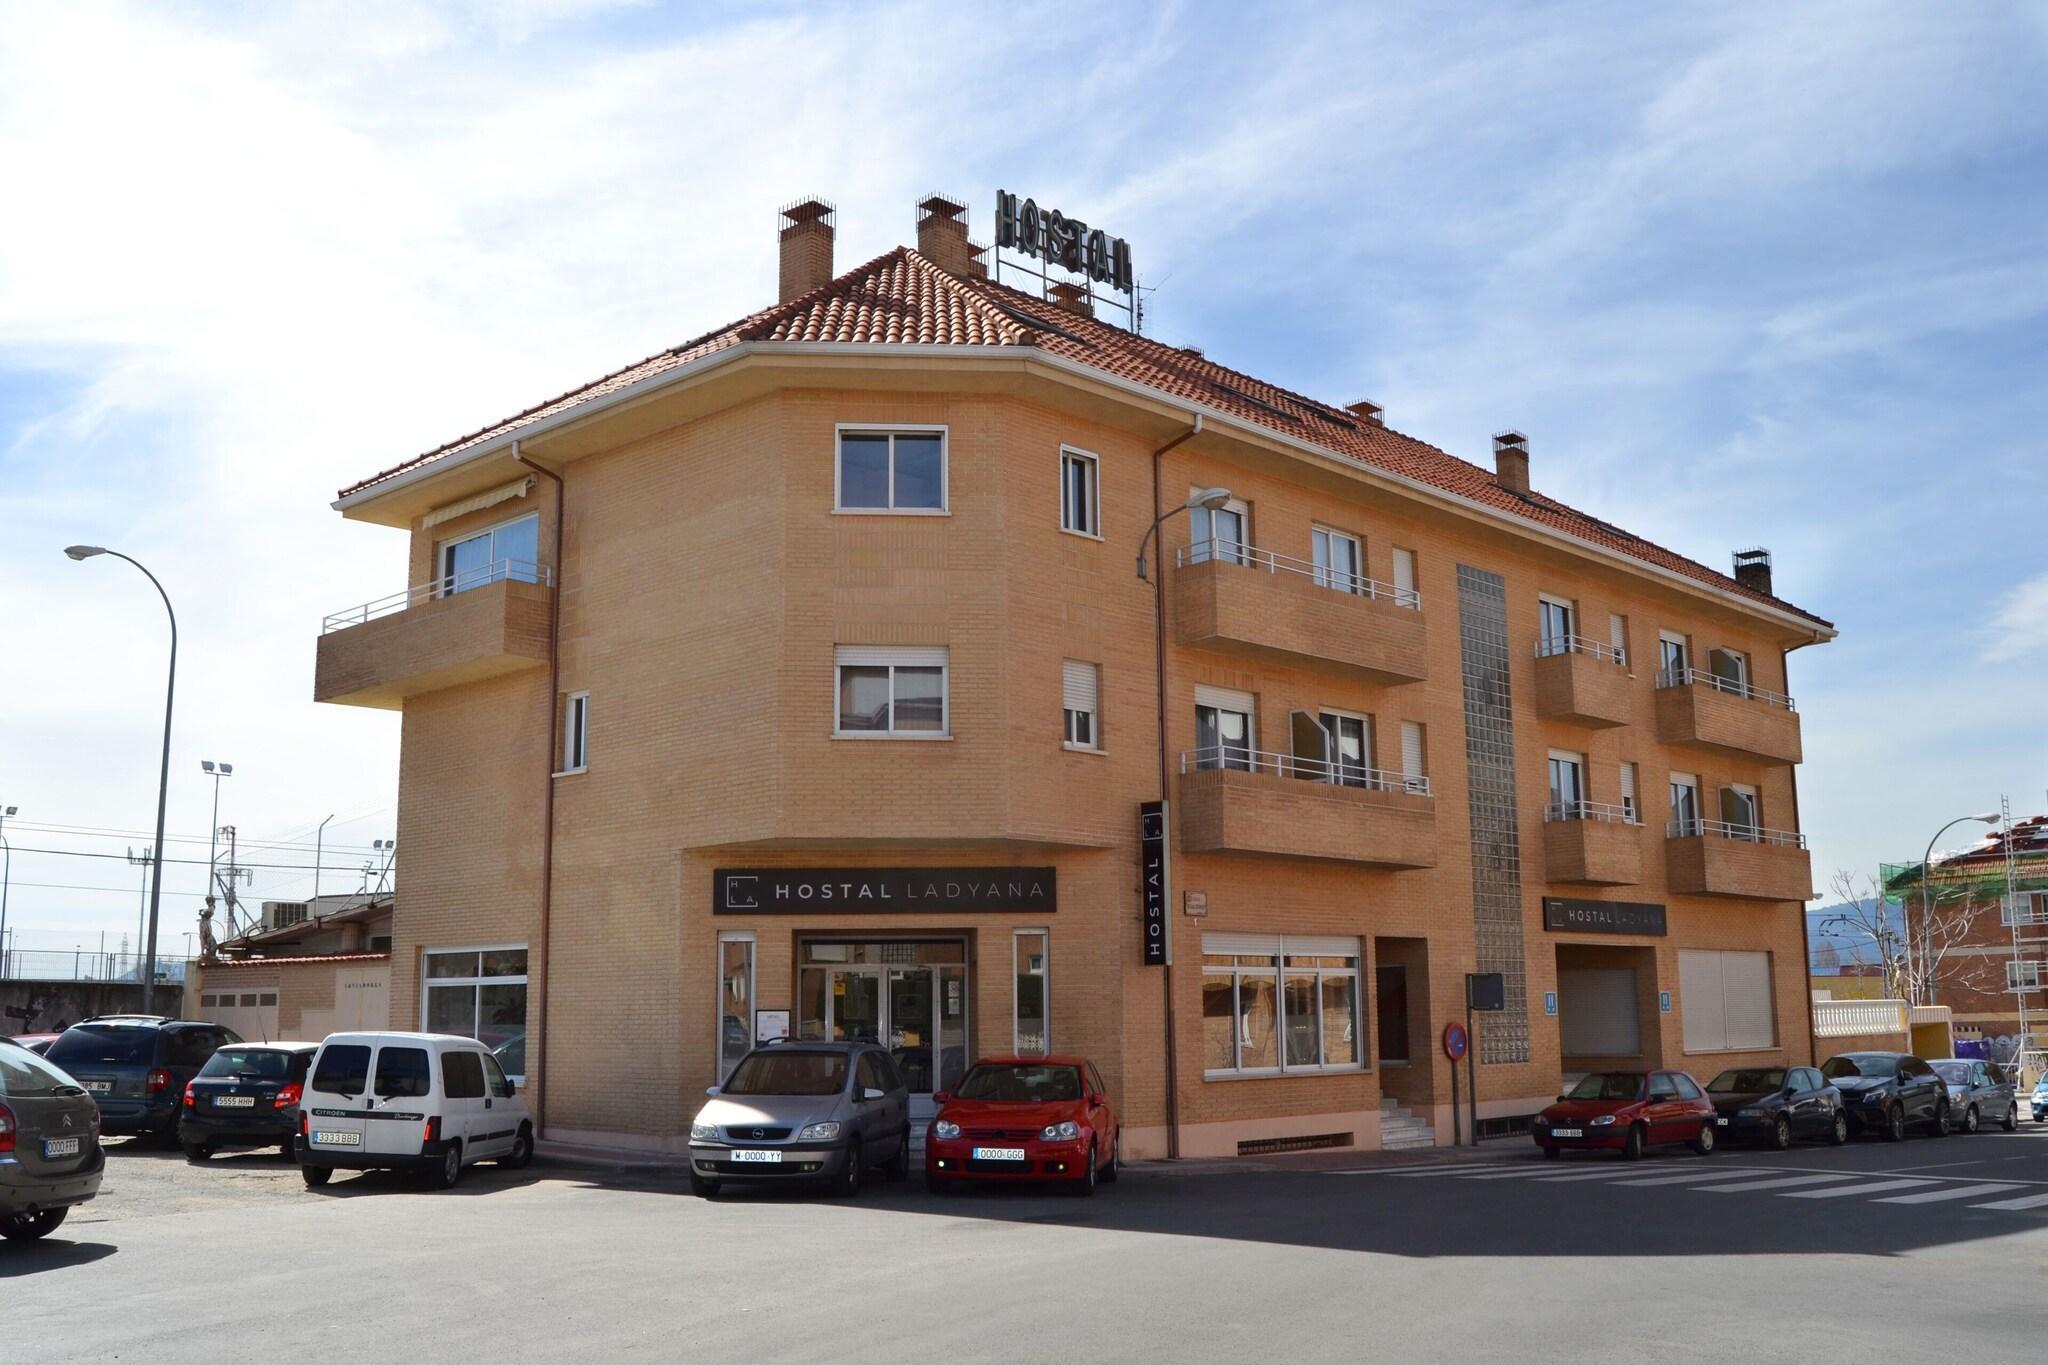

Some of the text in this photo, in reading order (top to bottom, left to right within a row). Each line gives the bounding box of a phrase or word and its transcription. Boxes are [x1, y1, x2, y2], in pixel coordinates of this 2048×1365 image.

[996, 189, 1133, 294] HOSTAL
[730, 880, 738, 888] H
[775, 882, 1044, 899] HOSTAL LADYANA
[1149, 858, 1160, 956] HOSTAL
[1569, 909, 1612, 923] HOSTAL
[218, 1096, 237, 1105] 5555
[319, 1133, 340, 1143] 3333
[48, 1141, 64, 1154] 0000
[980, 1149, 1024, 1159] 0000 GGG
